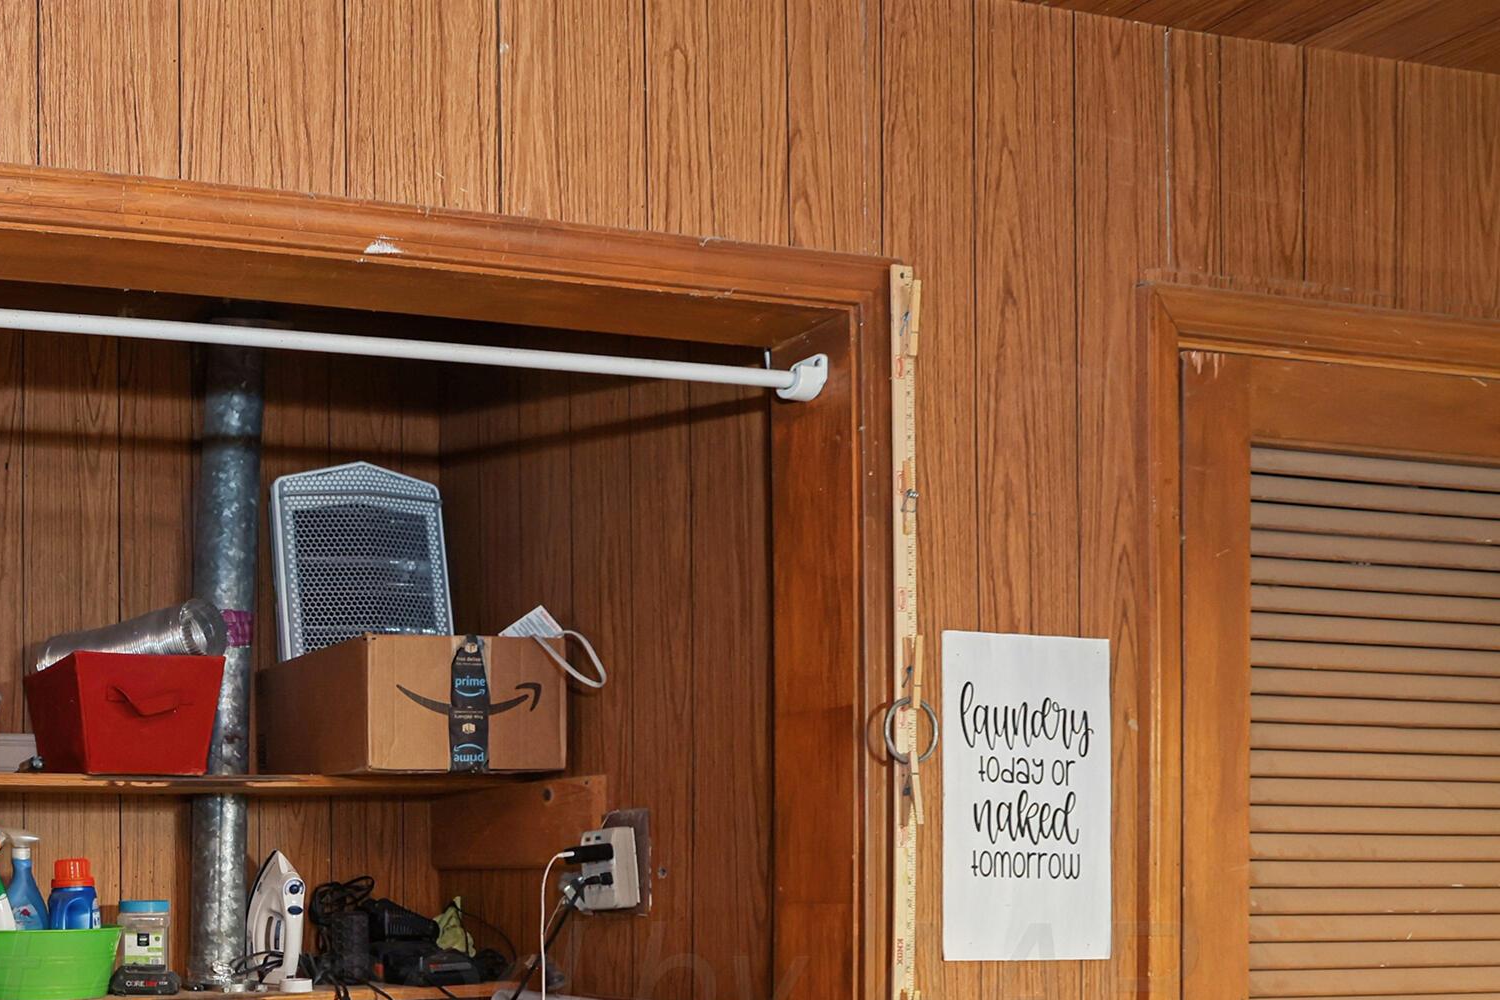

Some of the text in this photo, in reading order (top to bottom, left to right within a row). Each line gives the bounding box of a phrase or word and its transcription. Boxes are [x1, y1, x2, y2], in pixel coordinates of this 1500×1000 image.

[455, 675, 485, 688] prime
[960, 681, 1094, 757] laundry
[978, 756, 1076, 786] today or
[973, 790, 1080, 846] naked
[971, 849, 1081, 880] tomorrow
